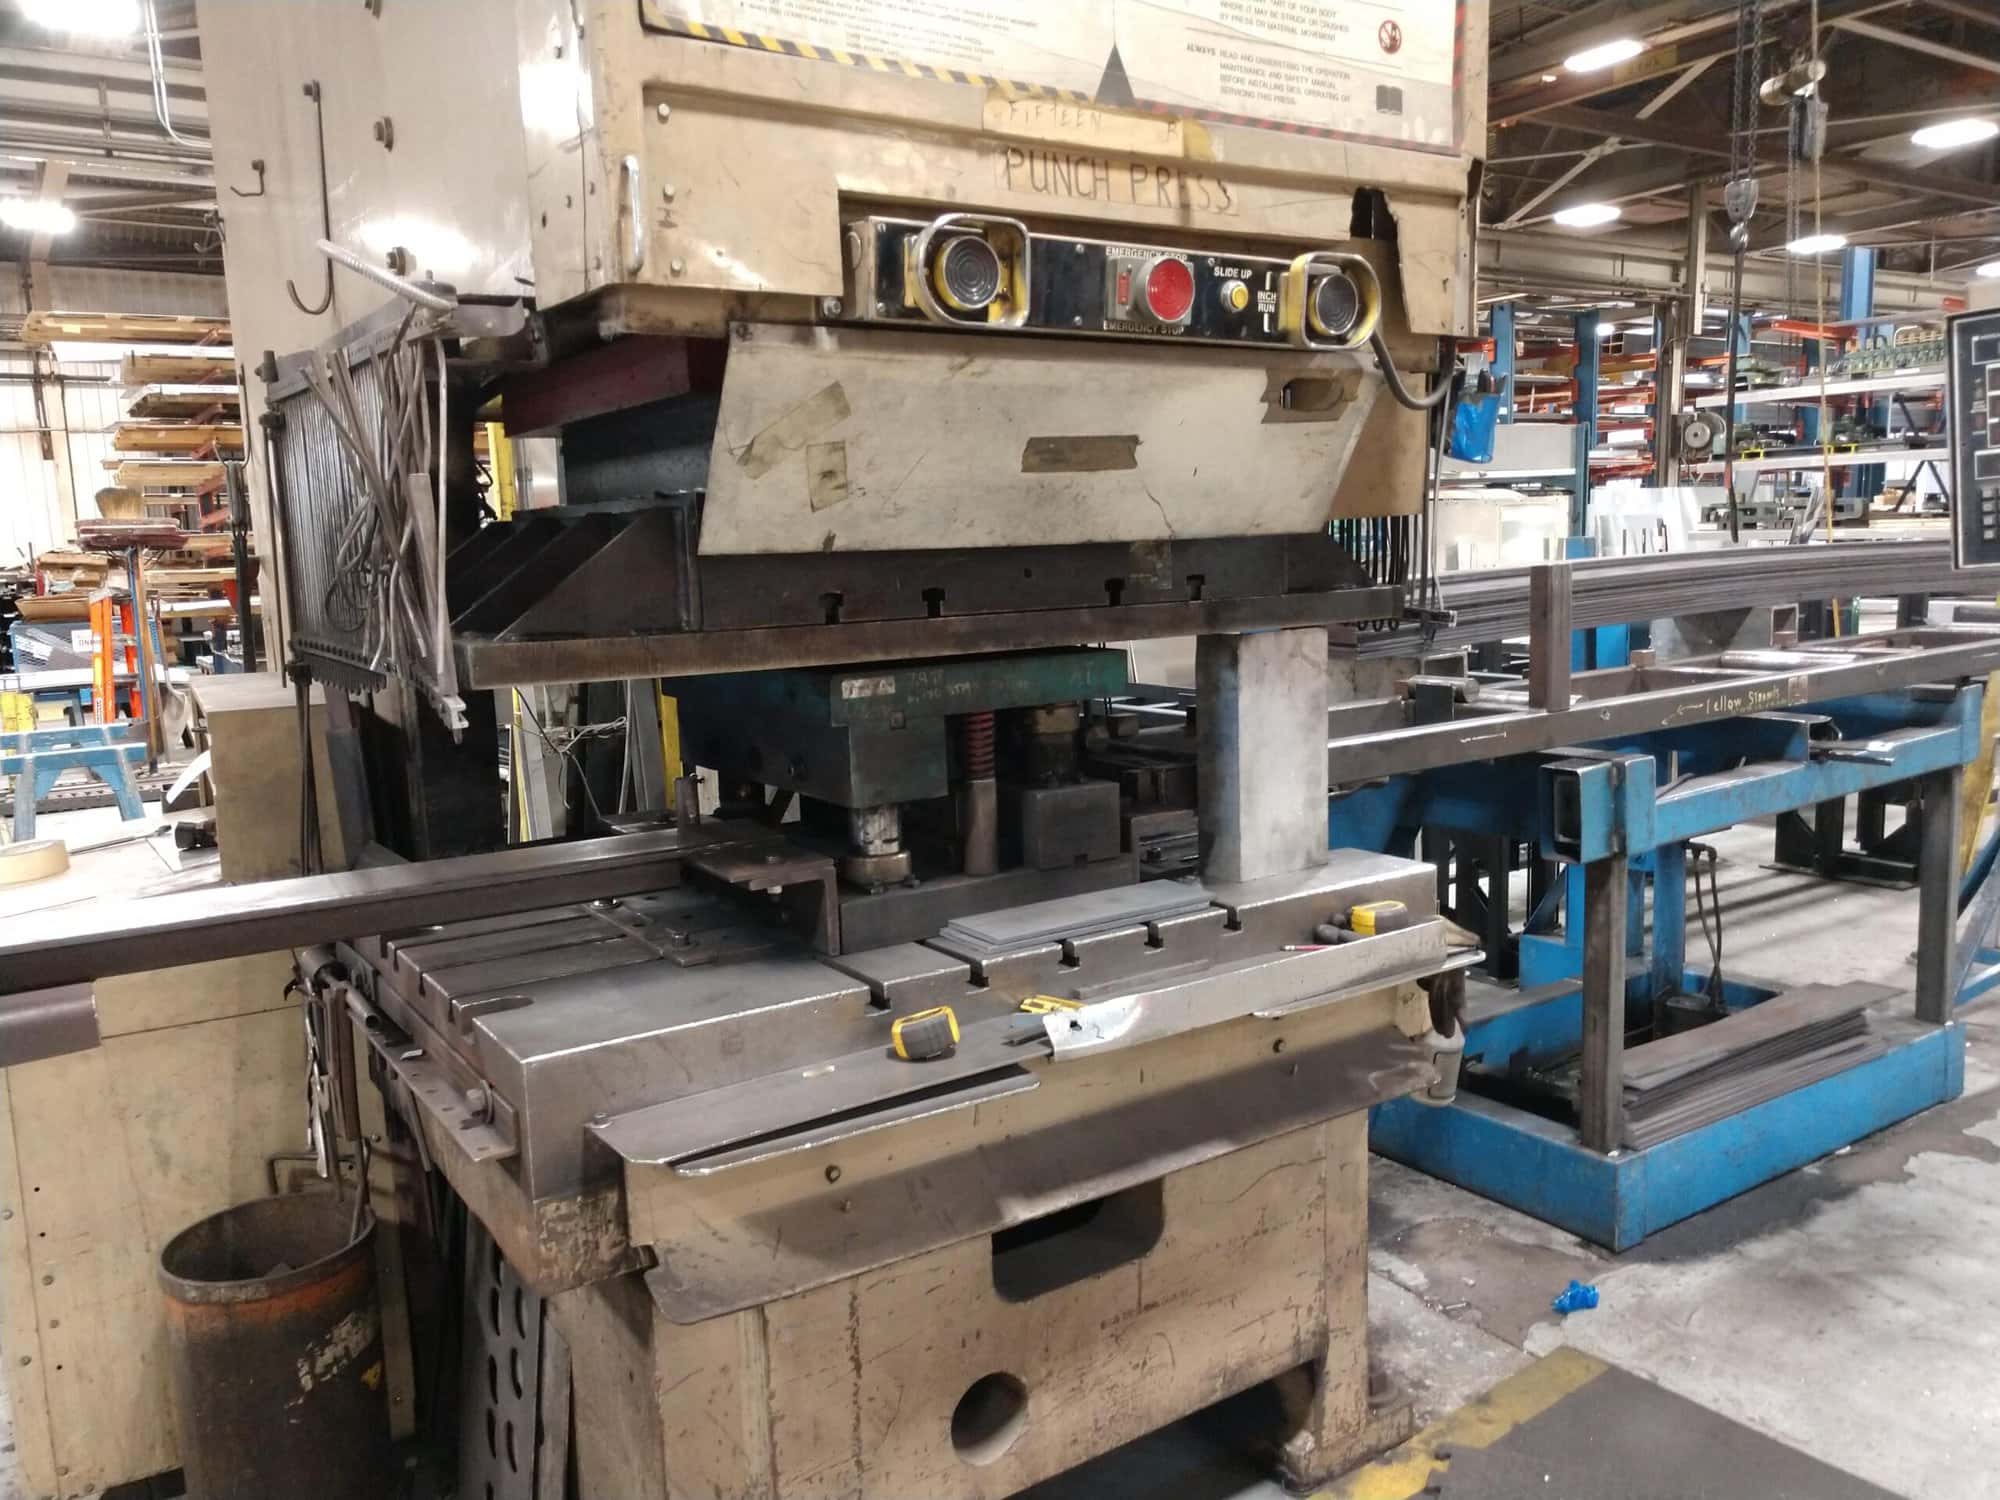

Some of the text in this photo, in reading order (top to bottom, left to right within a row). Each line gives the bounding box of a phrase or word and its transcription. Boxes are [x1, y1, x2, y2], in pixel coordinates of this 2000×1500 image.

[1186, 43, 1216, 56] ALWAYS
[1219, 48, 1238, 60] READ
[1301, 63, 1314, 74] THE
[1284, 73, 1309, 85] SAFETY
[1004, 147, 1232, 215] PUNCH PRESS
[1105, 246, 1162, 259] EMERGENCY
[1214, 266, 1253, 281] SLIDE UP
[1257, 290, 1277, 301] INCH
[1257, 302, 1276, 314] RUN
[1103, 319, 1185, 336] EMERGENCY STOP
